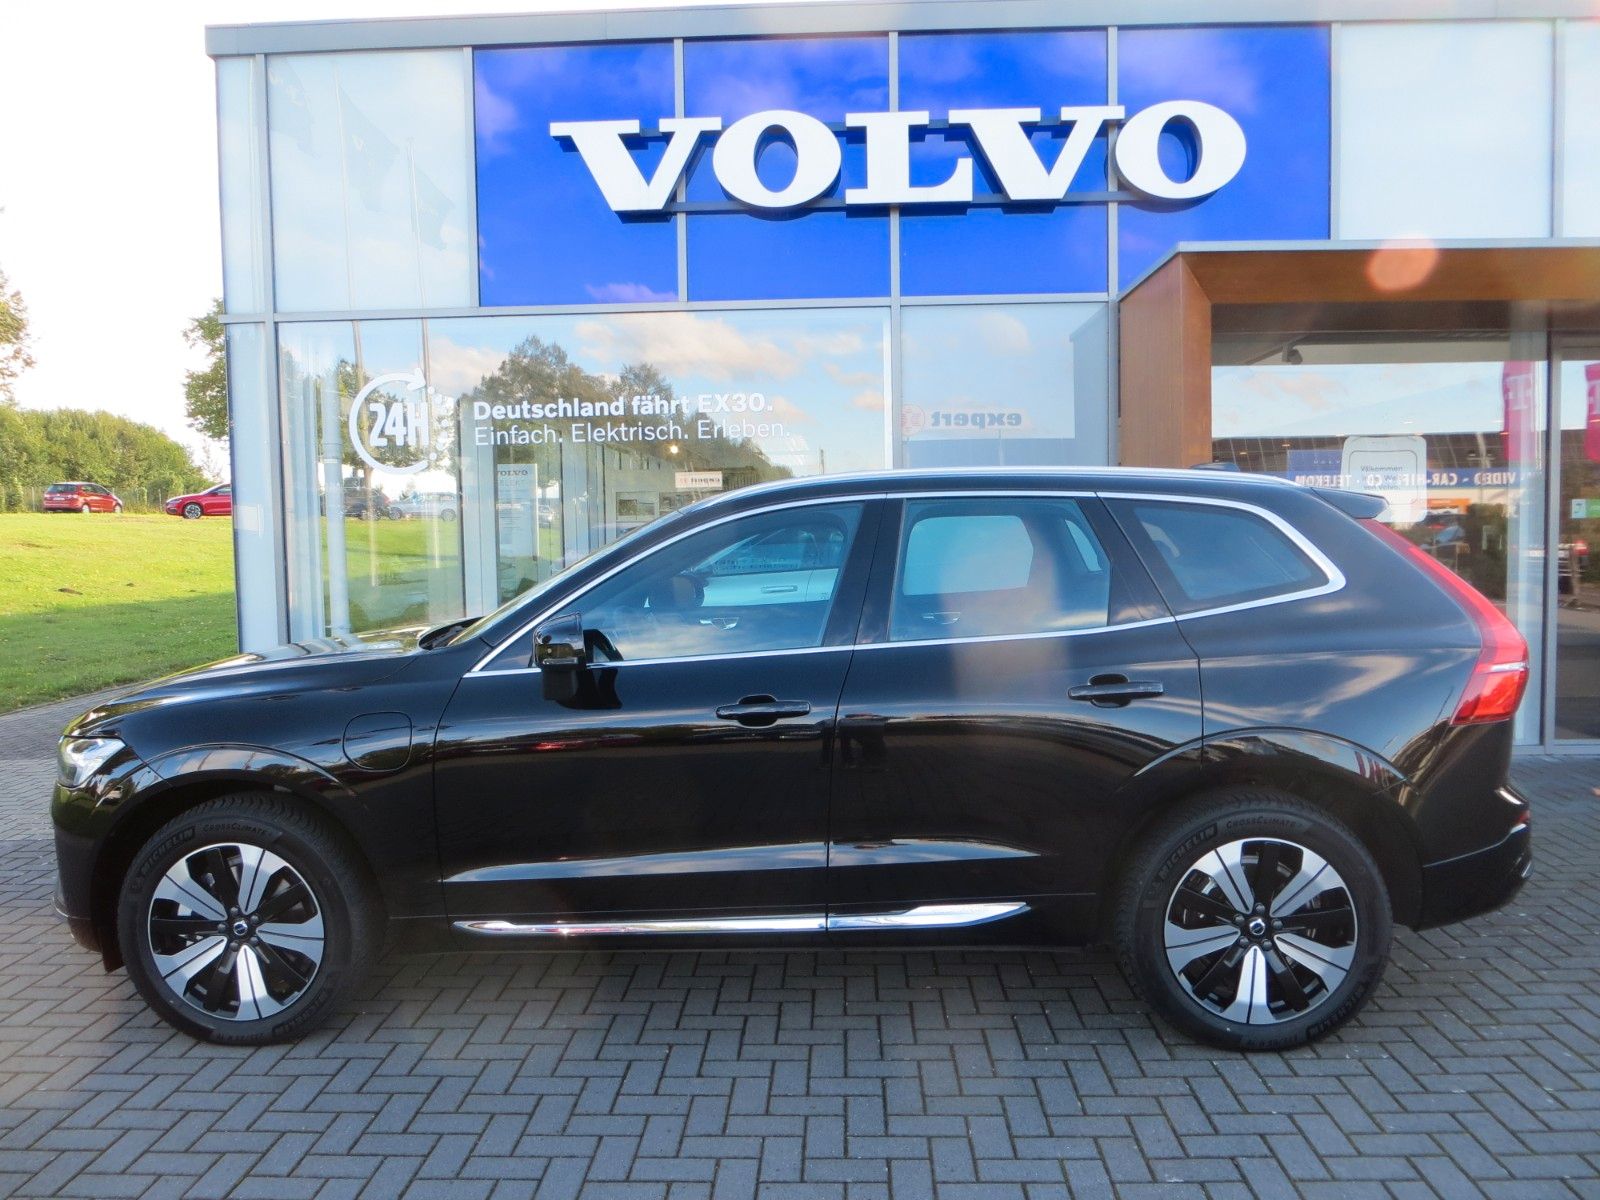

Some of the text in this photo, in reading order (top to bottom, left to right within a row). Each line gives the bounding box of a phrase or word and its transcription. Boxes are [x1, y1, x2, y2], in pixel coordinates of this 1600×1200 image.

[549, 100, 1247, 212] VOLVO
[369, 401, 430, 447] 24H
[473, 392, 774, 420] Deutschland fährt EX30.
[475, 419, 791, 446] Einfach. Elektrisch. Erleben.
[140, 827, 195, 875] MICHELIN
[1157, 825, 1216, 880] MICHELIN
